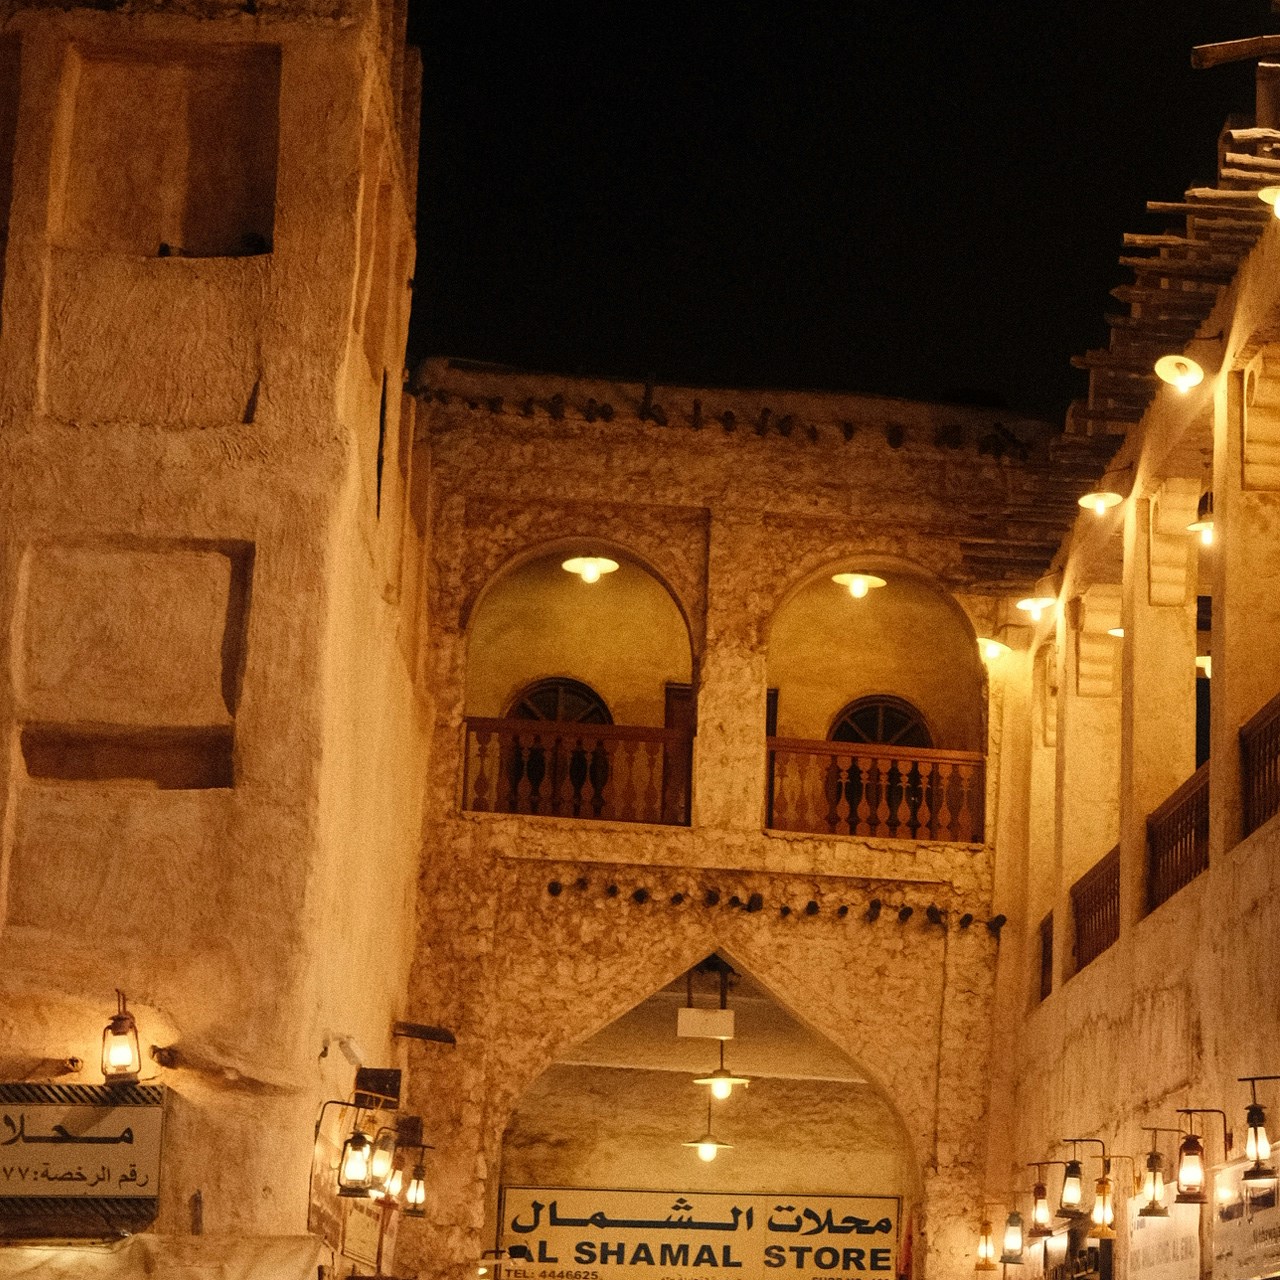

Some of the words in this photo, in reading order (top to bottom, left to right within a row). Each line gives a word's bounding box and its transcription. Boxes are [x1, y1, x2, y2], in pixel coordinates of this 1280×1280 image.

[117, 1163, 149, 1190] رقم
[511, 1196, 754, 1235] الشمال
[767, 1204, 893, 1236] محلات
[574, 1240, 743, 1269] SHAMAL
[763, 1244, 892, 1271] STORE
[538, 1270, 599, 1280] 4446625
